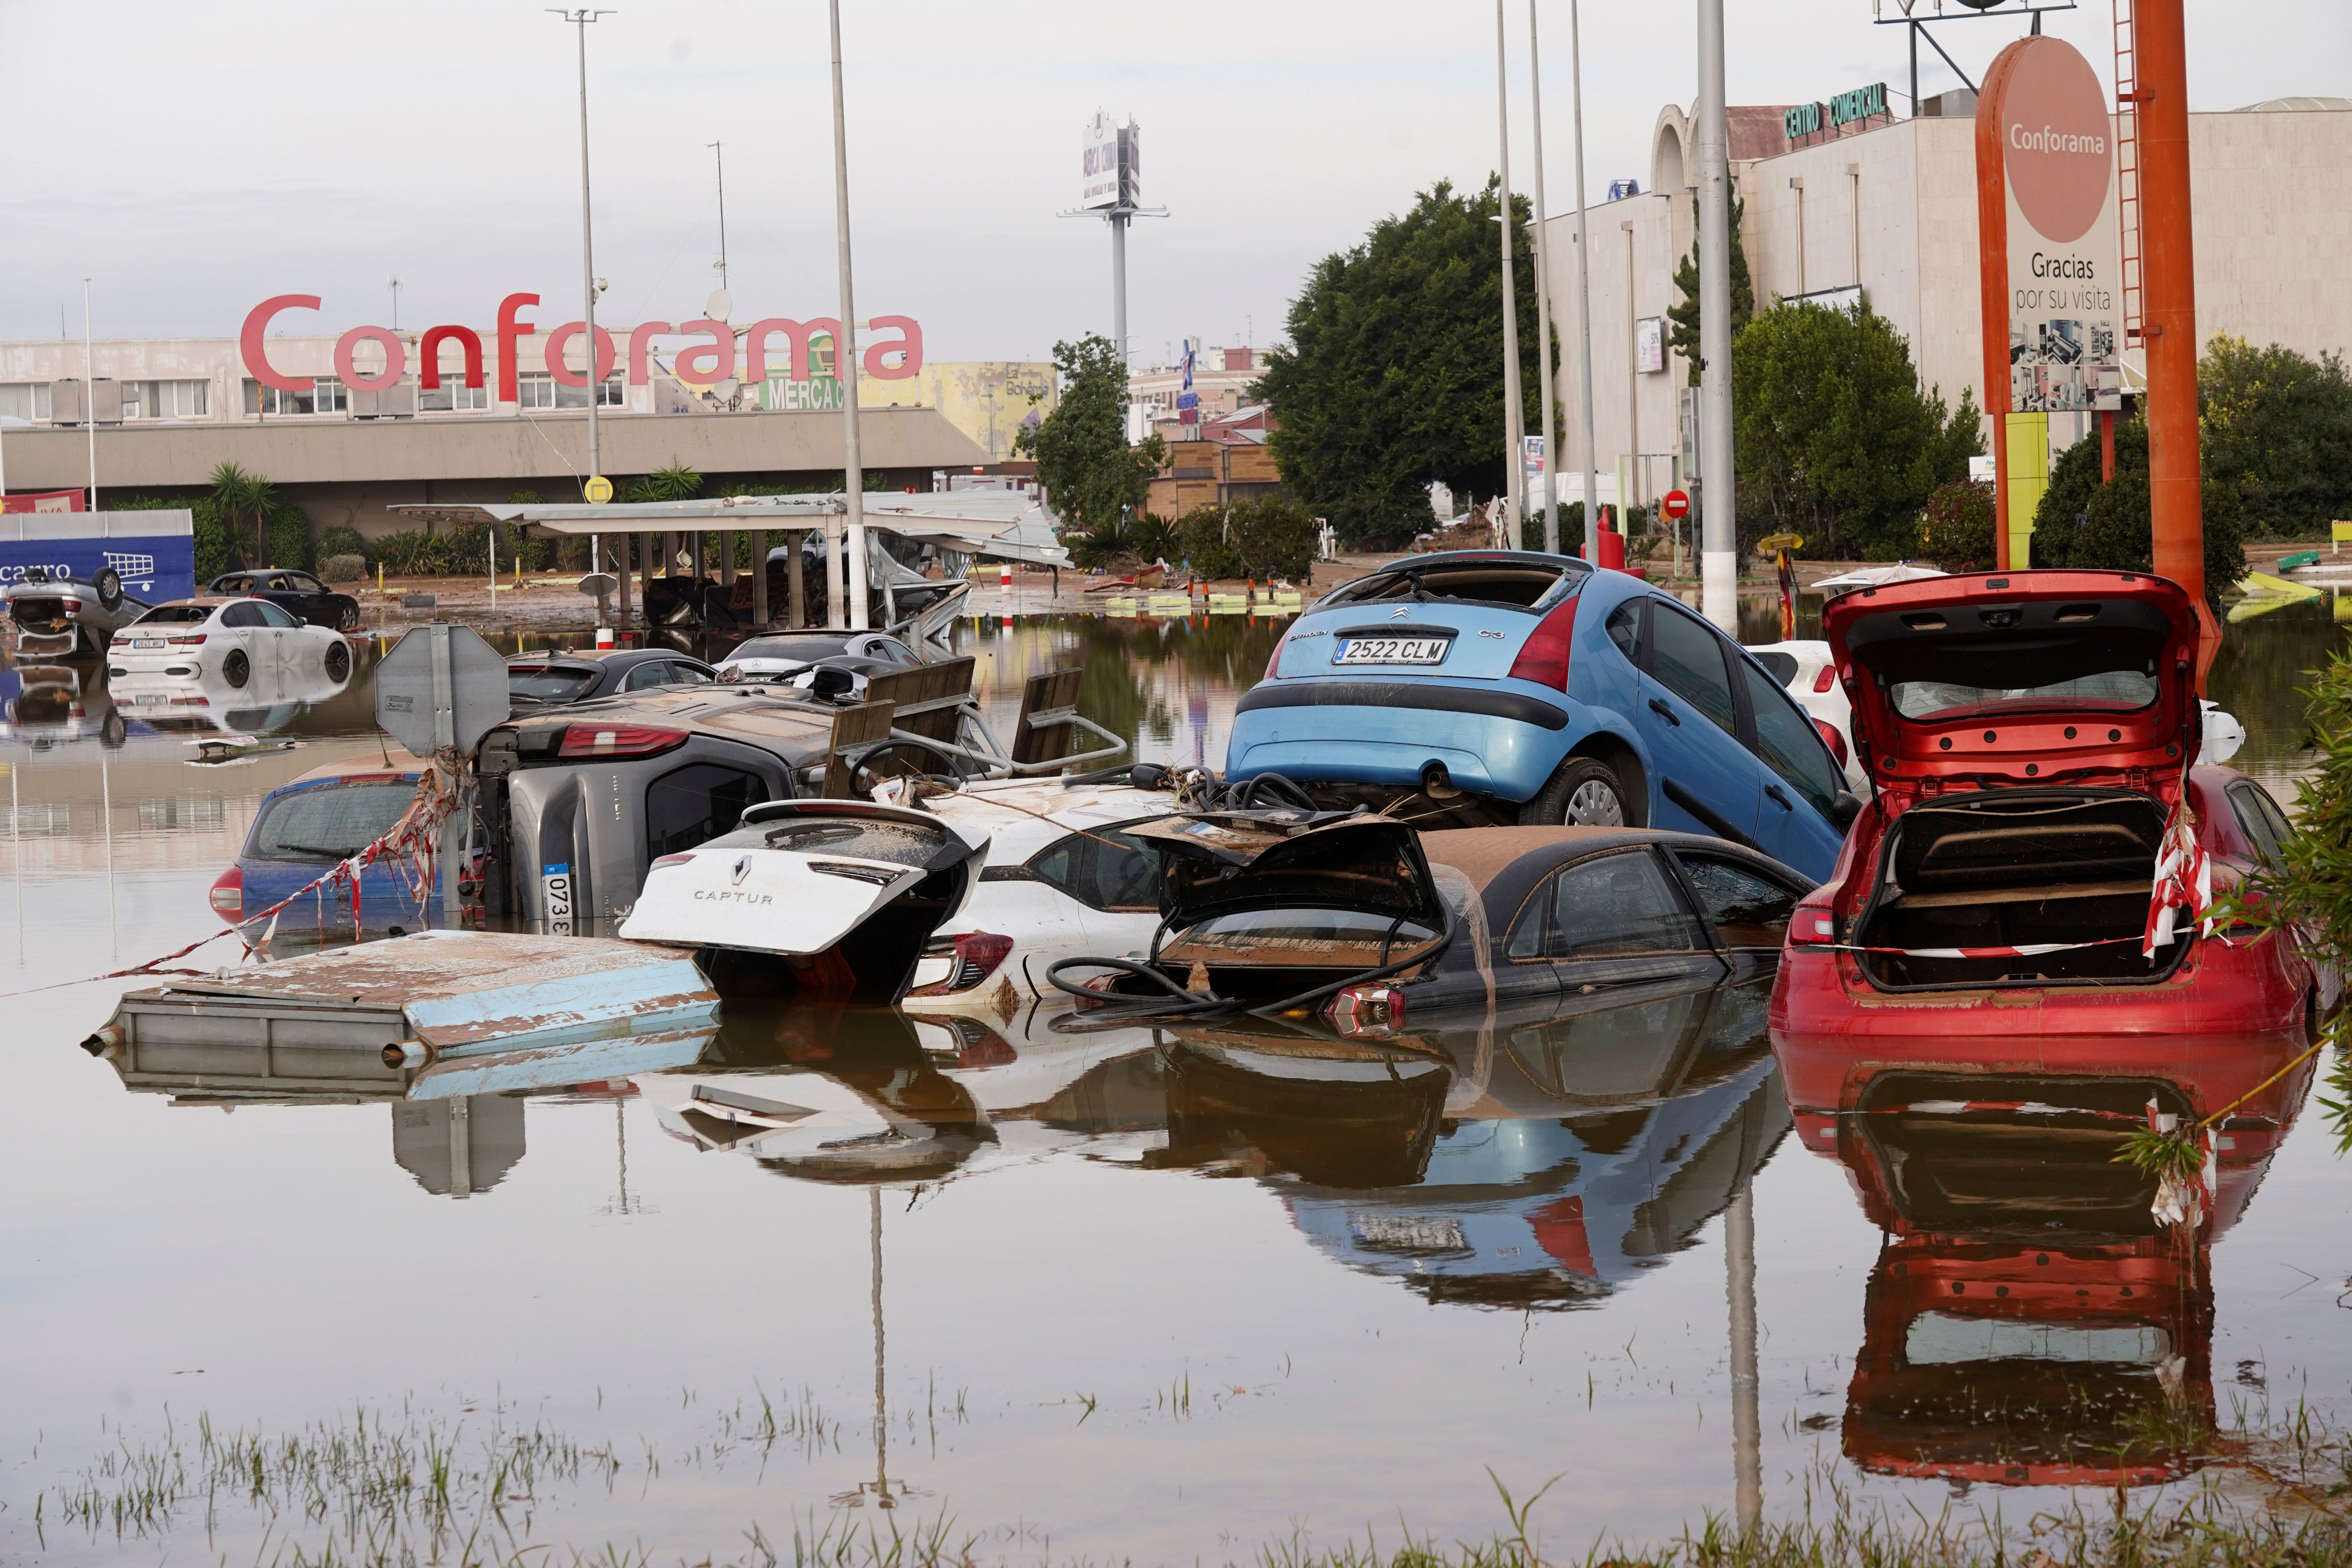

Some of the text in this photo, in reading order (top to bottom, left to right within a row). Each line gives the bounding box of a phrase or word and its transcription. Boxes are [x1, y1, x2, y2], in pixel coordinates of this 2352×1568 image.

[1784, 82, 1886, 138] CENTRO COMERCIAL
[2010, 123, 2104, 155] Conforama
[2032, 252, 2094, 280] Gracias
[2016, 285, 2111, 315] por su visita
[240, 292, 922, 402] Conforama
[1006, 364, 1018, 379] La
[768, 378, 833, 410] MERCA
[1478, 630, 1505, 639] C3
[1347, 641, 1398, 658] 2522
[1401, 642, 1443, 659] CLM
[550, 878, 569, 916] 073
[694, 890, 773, 905] CAPTUR
